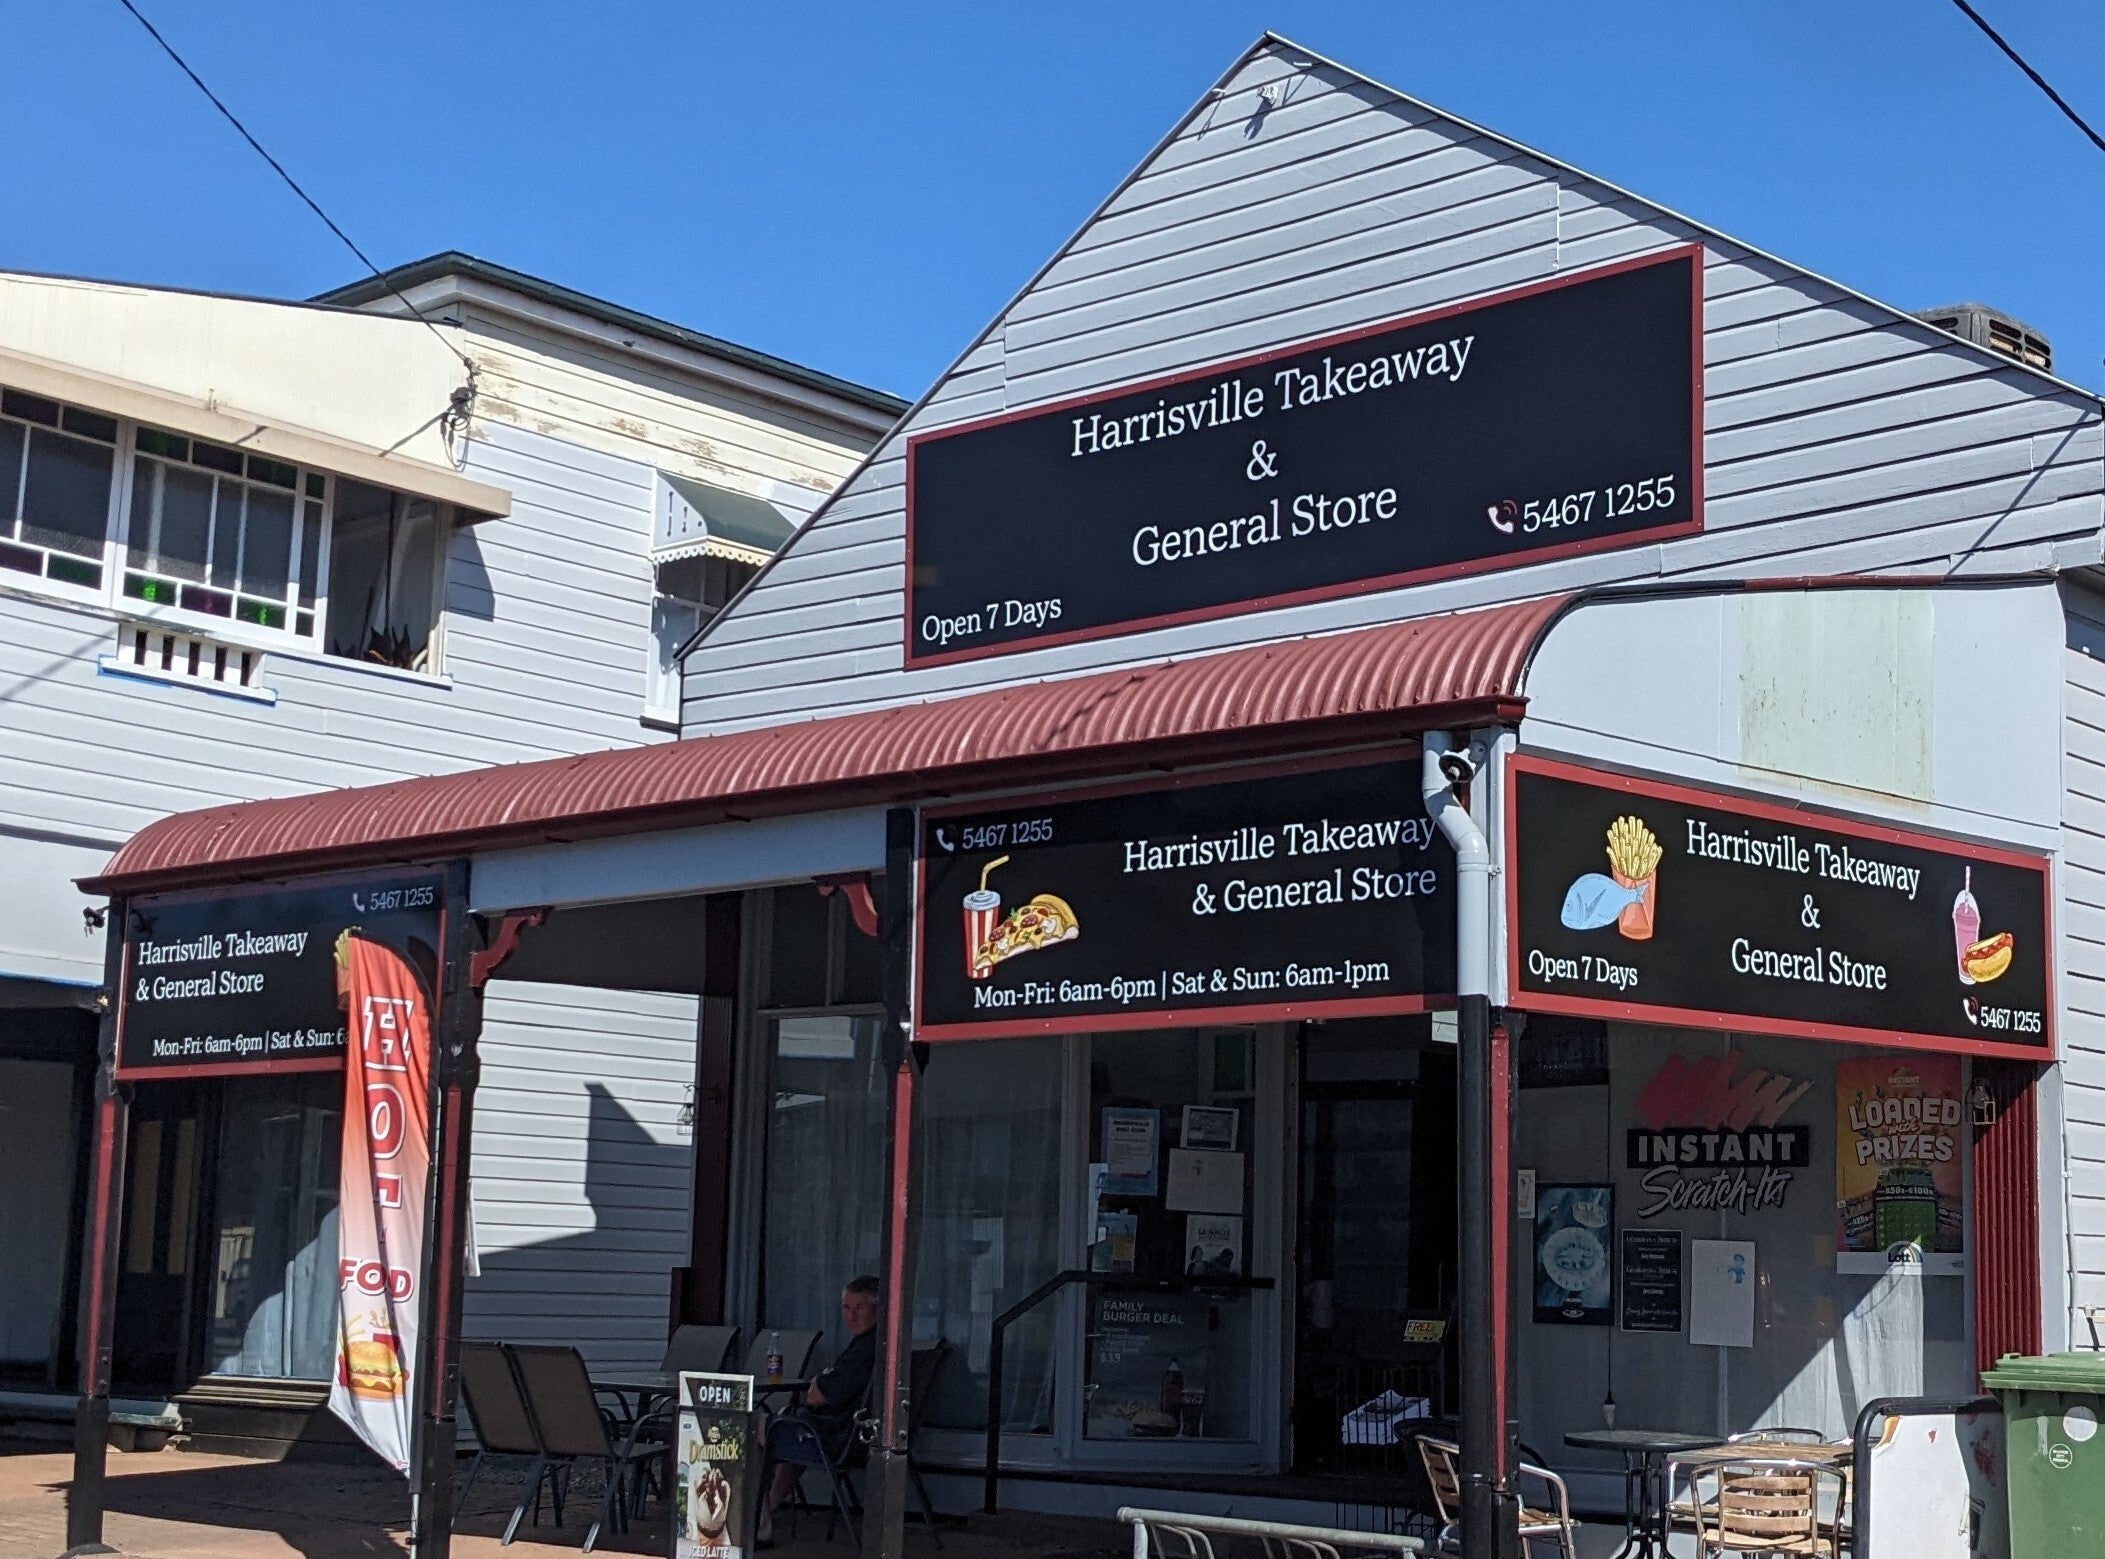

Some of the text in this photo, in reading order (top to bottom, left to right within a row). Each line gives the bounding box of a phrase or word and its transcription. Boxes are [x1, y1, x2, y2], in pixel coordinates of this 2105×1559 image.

[1070, 334, 1475, 458] Harrisville Takeaway
[1245, 438, 1279, 481] &
[1521, 474, 1676, 534] 5467 1255
[1132, 486, 1398, 567] General Store
[921, 595, 1062, 647] Open 7 Days
[961, 817, 1053, 850] 5467 1255
[1123, 814, 1436, 873] Harrisville Takeaway
[1686, 818, 1921, 900] Harrisville Takeaway
[370, 886, 435, 911] 5467 1255
[1191, 865, 1437, 916] & General Store
[1800, 894, 1821, 929] &
[138, 929, 309, 966] Harrisville Takeaway
[1731, 937, 1887, 990] General Store
[135, 971, 264, 1001] & General Store
[973, 980, 1055, 1010] Mon-Fri:
[1058, 977, 1157, 1006] 6am-6pm
[1171, 969, 1206, 996] Sat
[1208, 969, 1228, 992] &
[1232, 966, 1280, 992] Sun:
[1284, 960, 1390, 989] 6am-1pm
[1528, 949, 1638, 991] Open 7 Days
[1980, 1005, 2042, 1034] 5467 1255
[153, 1035, 204, 1057] Mon-Fri:
[204, 1033, 263, 1056] 6am-6pm
[271, 1031, 292, 1050] Sat
[292, 1031, 305, 1048] &
[306, 1028, 335, 1048] Sun:
[1848, 1096, 1961, 1131] LOADED
[1887, 1115, 1921, 1135] with
[1638, 1133, 1796, 1163] INSTANT
[1855, 1134, 1955, 1166] PRIZES
[1103, 1300, 1145, 1312] FAMILY
[1103, 1311, 1184, 1325] BURGER DEAL
[699, 1385, 731, 1404] OPEN
